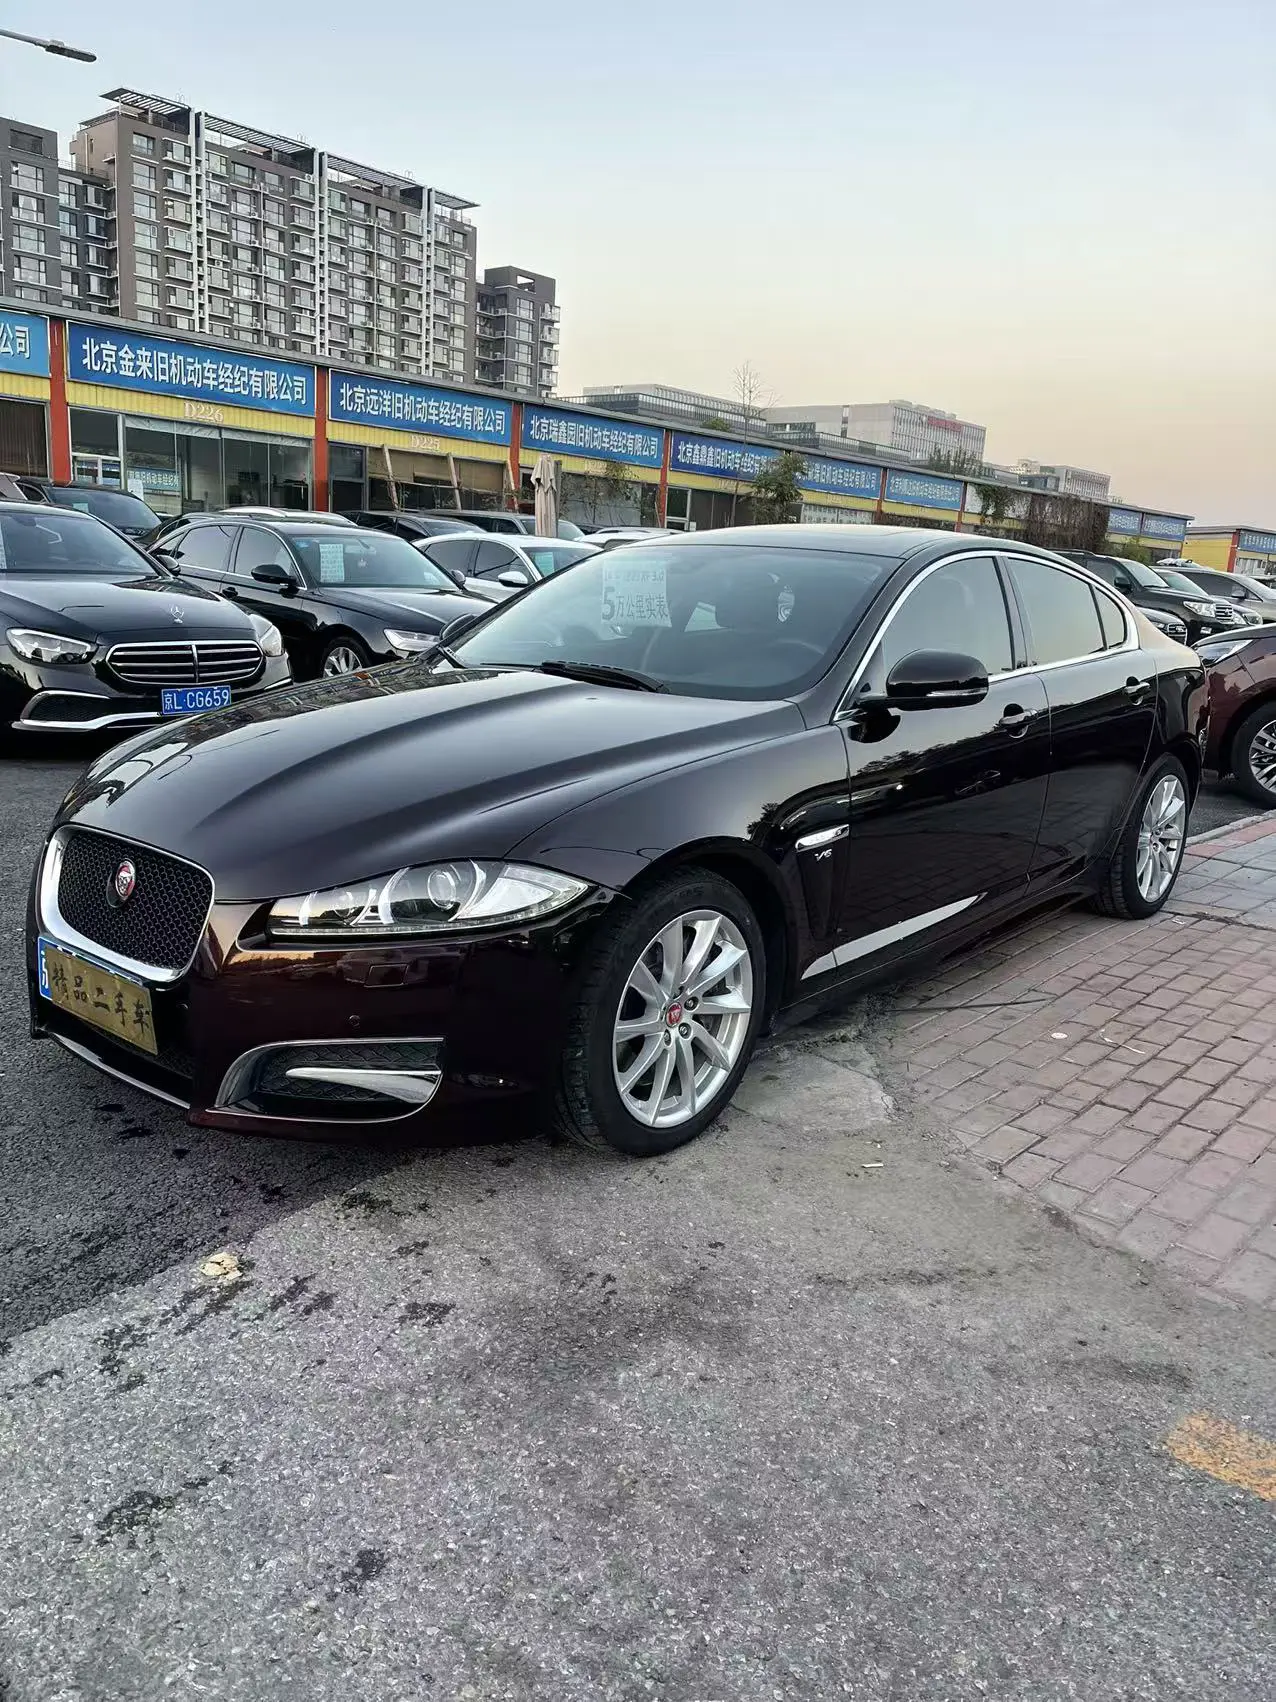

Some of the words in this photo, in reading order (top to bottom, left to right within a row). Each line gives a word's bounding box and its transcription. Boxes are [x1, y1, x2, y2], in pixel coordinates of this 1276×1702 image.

[0, 322, 30, 359] 公司
[82, 336, 307, 405] 北京金来旧机动车经纪有限公司
[184, 402, 224, 423] D226
[339, 382, 506, 435] 北京远洋旧机动车经纪有限公司
[411, 435, 440, 450] D225
[530, 415, 658, 459] 北京瑞鑫园旧机动车经纪有限公司
